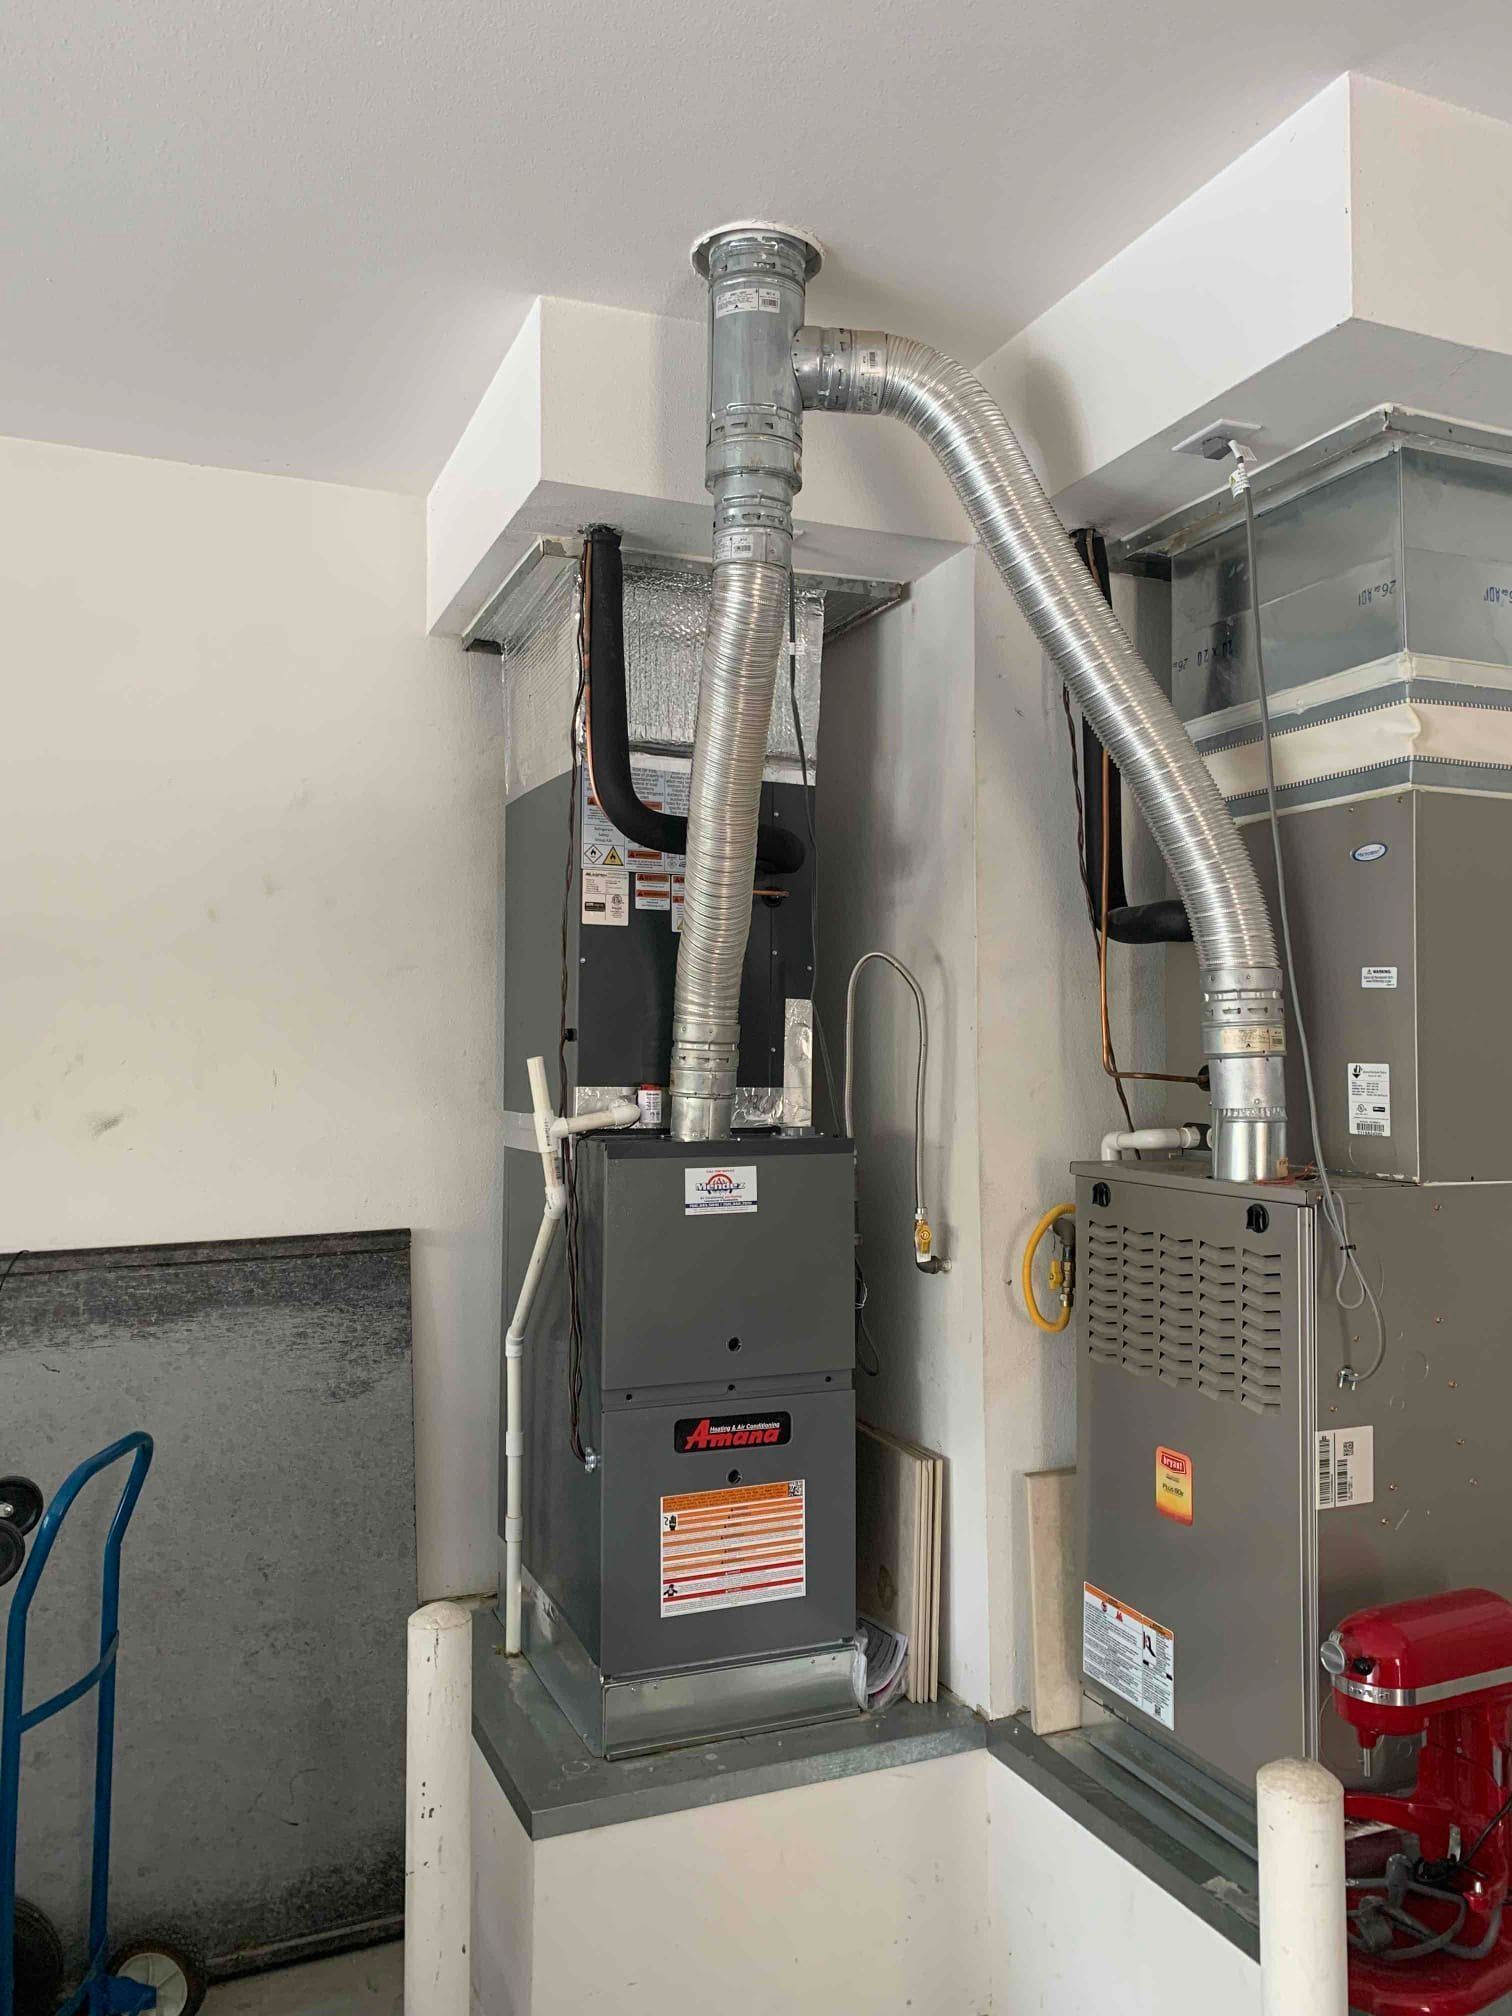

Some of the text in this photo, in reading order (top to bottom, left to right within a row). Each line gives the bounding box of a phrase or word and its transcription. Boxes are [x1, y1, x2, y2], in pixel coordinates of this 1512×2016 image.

[696, 1182, 746, 1192] Mendez
[710, 1425, 731, 1434] Heating
[737, 1423, 746, 1431] Air
[746, 1421, 781, 1430] Conditioning
[684, 1419, 780, 1450] Amana
